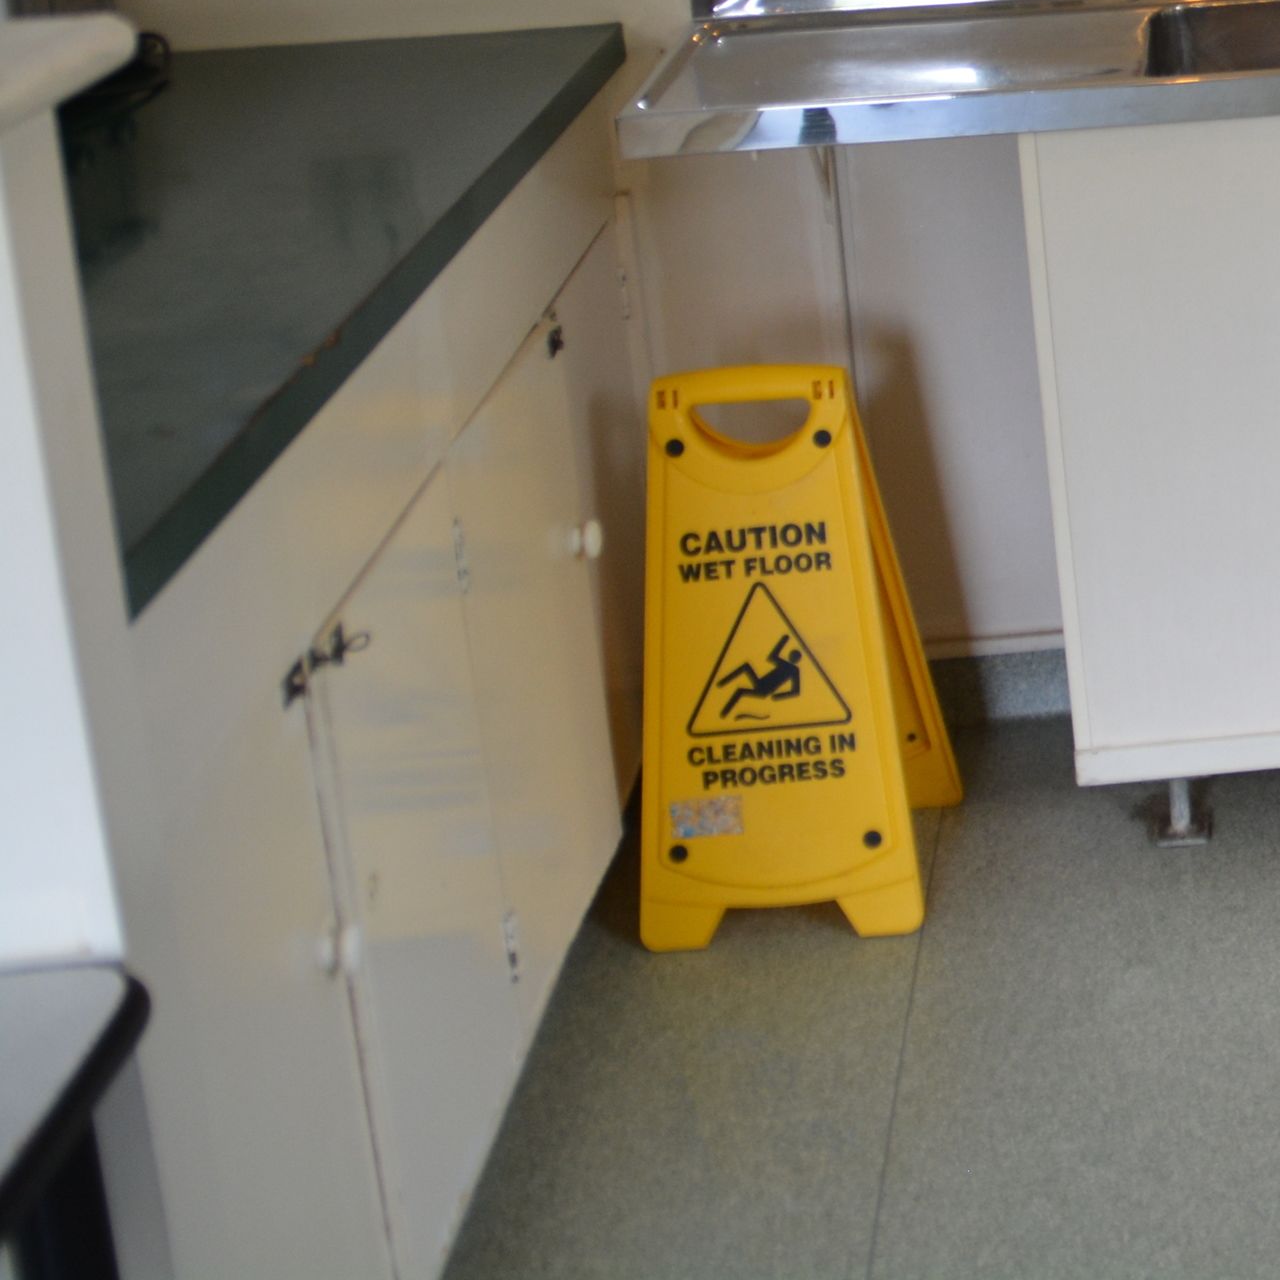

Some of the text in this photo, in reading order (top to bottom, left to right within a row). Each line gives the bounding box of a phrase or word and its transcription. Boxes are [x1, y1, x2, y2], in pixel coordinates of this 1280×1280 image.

[680, 522, 827, 557] CAUTION
[679, 552, 832, 583] WET FLOOR
[688, 733, 856, 767] CLEANING IN
[703, 759, 846, 791] PROGRESS
